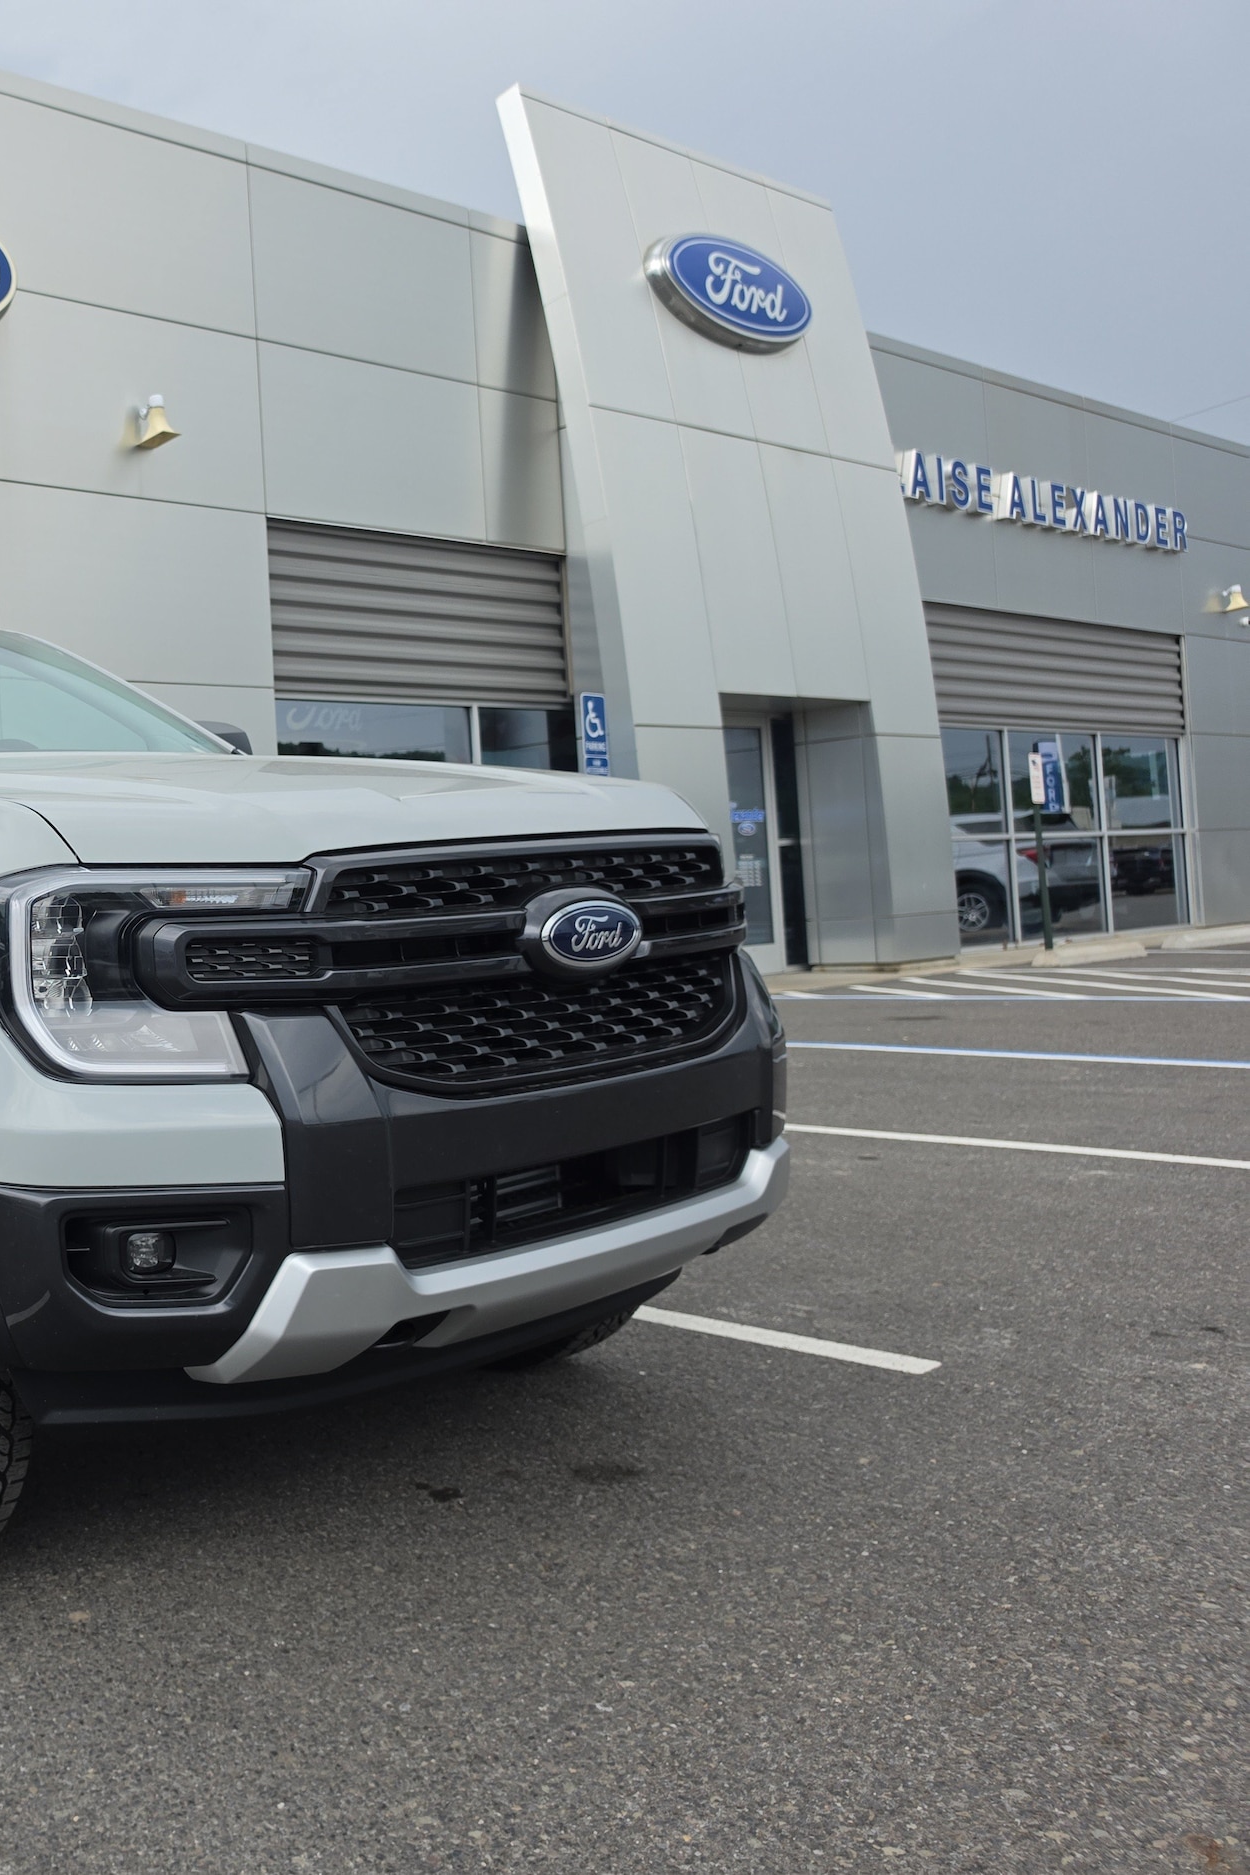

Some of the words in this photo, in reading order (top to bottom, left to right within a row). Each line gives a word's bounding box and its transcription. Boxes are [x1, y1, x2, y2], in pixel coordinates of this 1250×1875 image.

[705, 250, 788, 322] Ford
[901, 448, 994, 514] AISE
[1005, 470, 1189, 552] ALEXANDER
[571, 915, 623, 953] Ford
